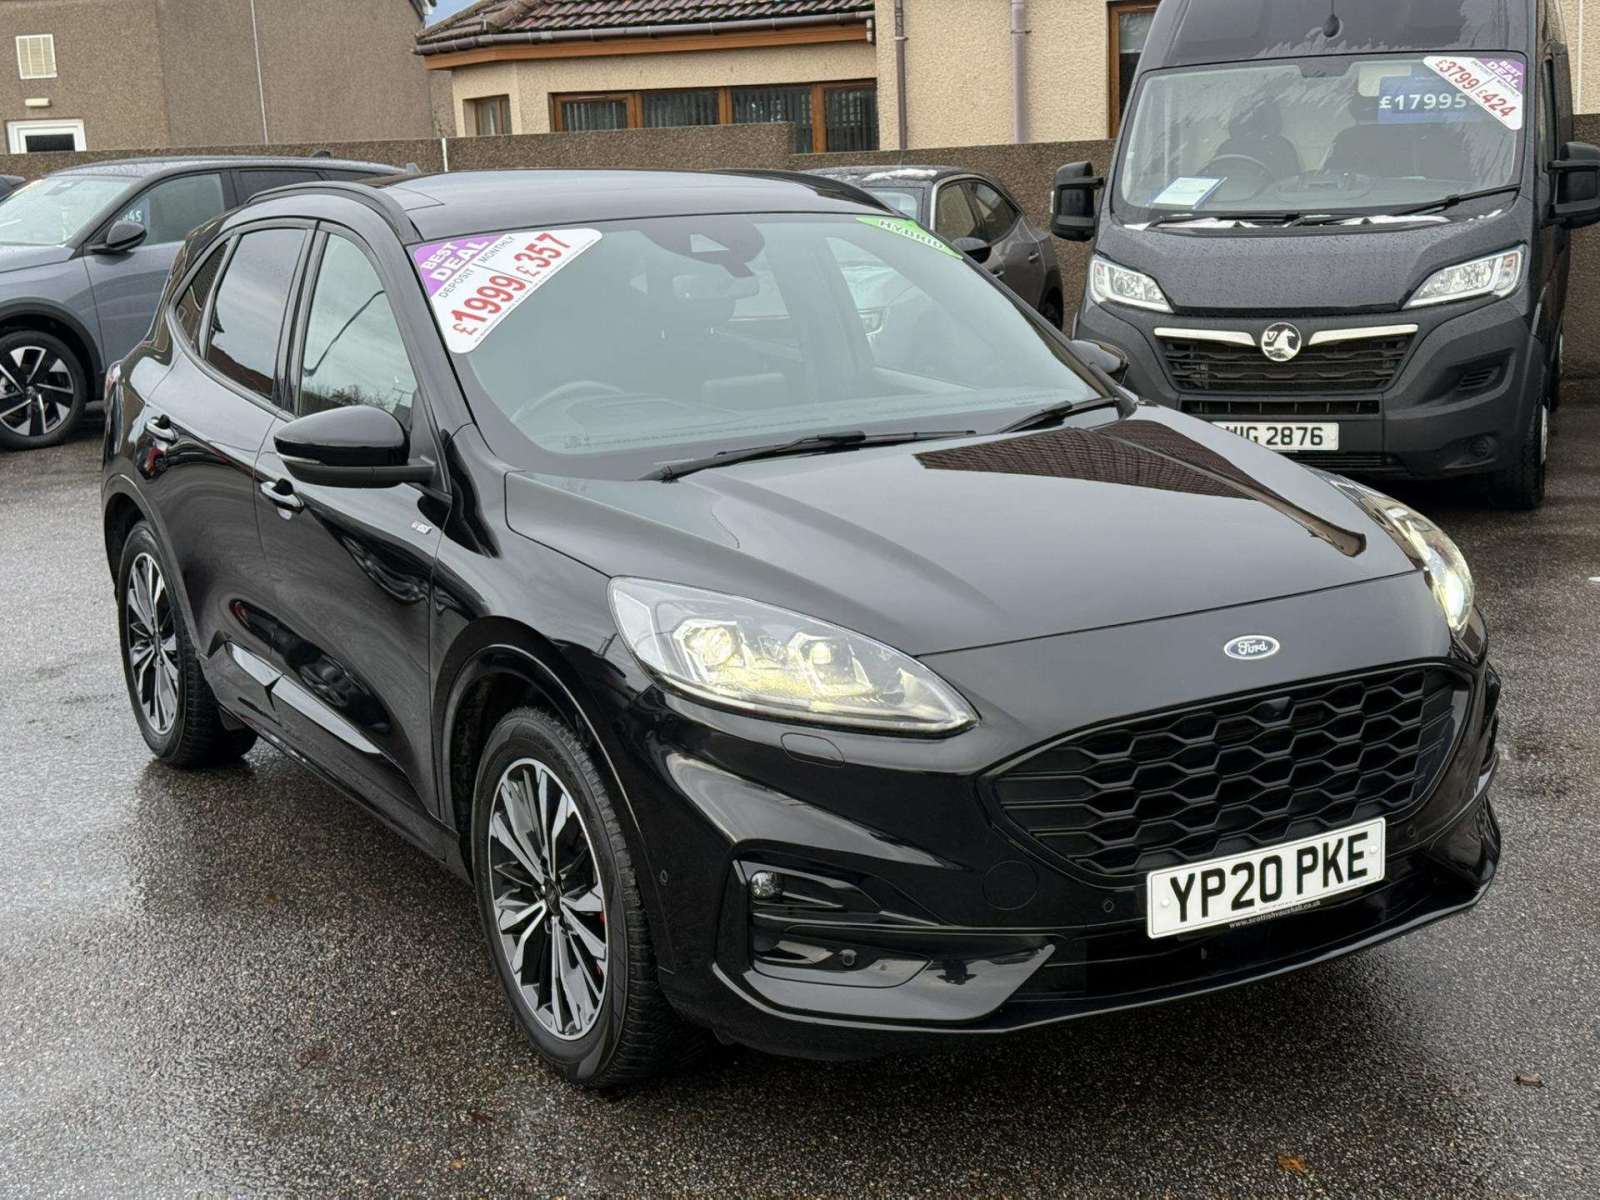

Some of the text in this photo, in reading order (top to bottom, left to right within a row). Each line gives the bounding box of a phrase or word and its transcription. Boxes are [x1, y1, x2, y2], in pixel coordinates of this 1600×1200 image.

[1486, 61, 1519, 87] DEAL
[1499, 60, 1522, 76] BEST
[1435, 59, 1480, 90] £3799
[1475, 89, 1517, 117] £424
[879, 219, 944, 250] HYBRID
[421, 242, 459, 270] BEST
[430, 241, 490, 281] DEAL
[439, 235, 516, 298] DEPOSIT MONTHLY
[451, 275, 527, 336] £1999
[514, 232, 571, 277] £357
[1265, 426, 1324, 446] 2876
[1238, 640, 1268, 655] Ford
[1169, 831, 1369, 923] YP20 PKE
